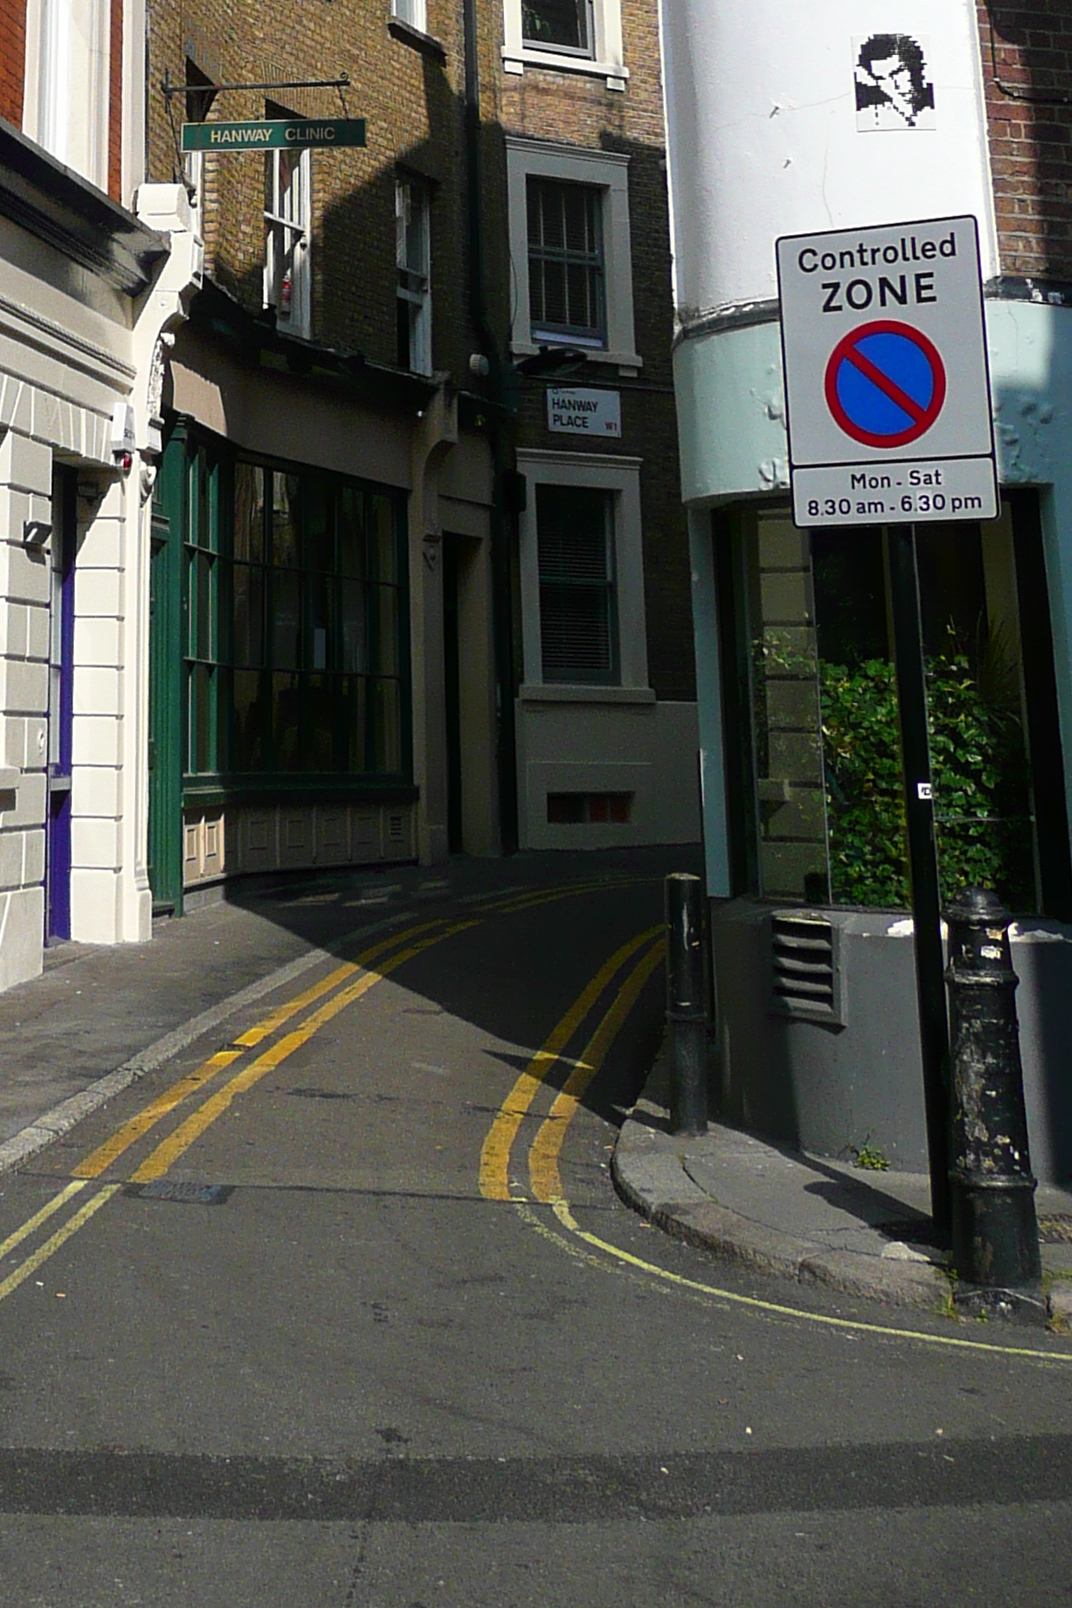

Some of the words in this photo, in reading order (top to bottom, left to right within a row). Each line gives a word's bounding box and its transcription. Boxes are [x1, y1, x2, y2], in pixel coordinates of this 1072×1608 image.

[210, 127, 273, 144] HANWAY
[284, 126, 336, 142] CLINIC
[797, 232, 957, 273] Controlled
[821, 271, 937, 313] ZONE
[551, 398, 599, 413] HANWAY
[552, 414, 590, 429] PLACE
[604, 421, 618, 431] W1
[850, 473, 891, 490] Mon
[908, 469, 943, 487] Sat
[807, 498, 852, 517] 8.30
[856, 500, 885, 515] am
[900, 494, 946, 513] 6.30
[951, 495, 983, 513] pm
